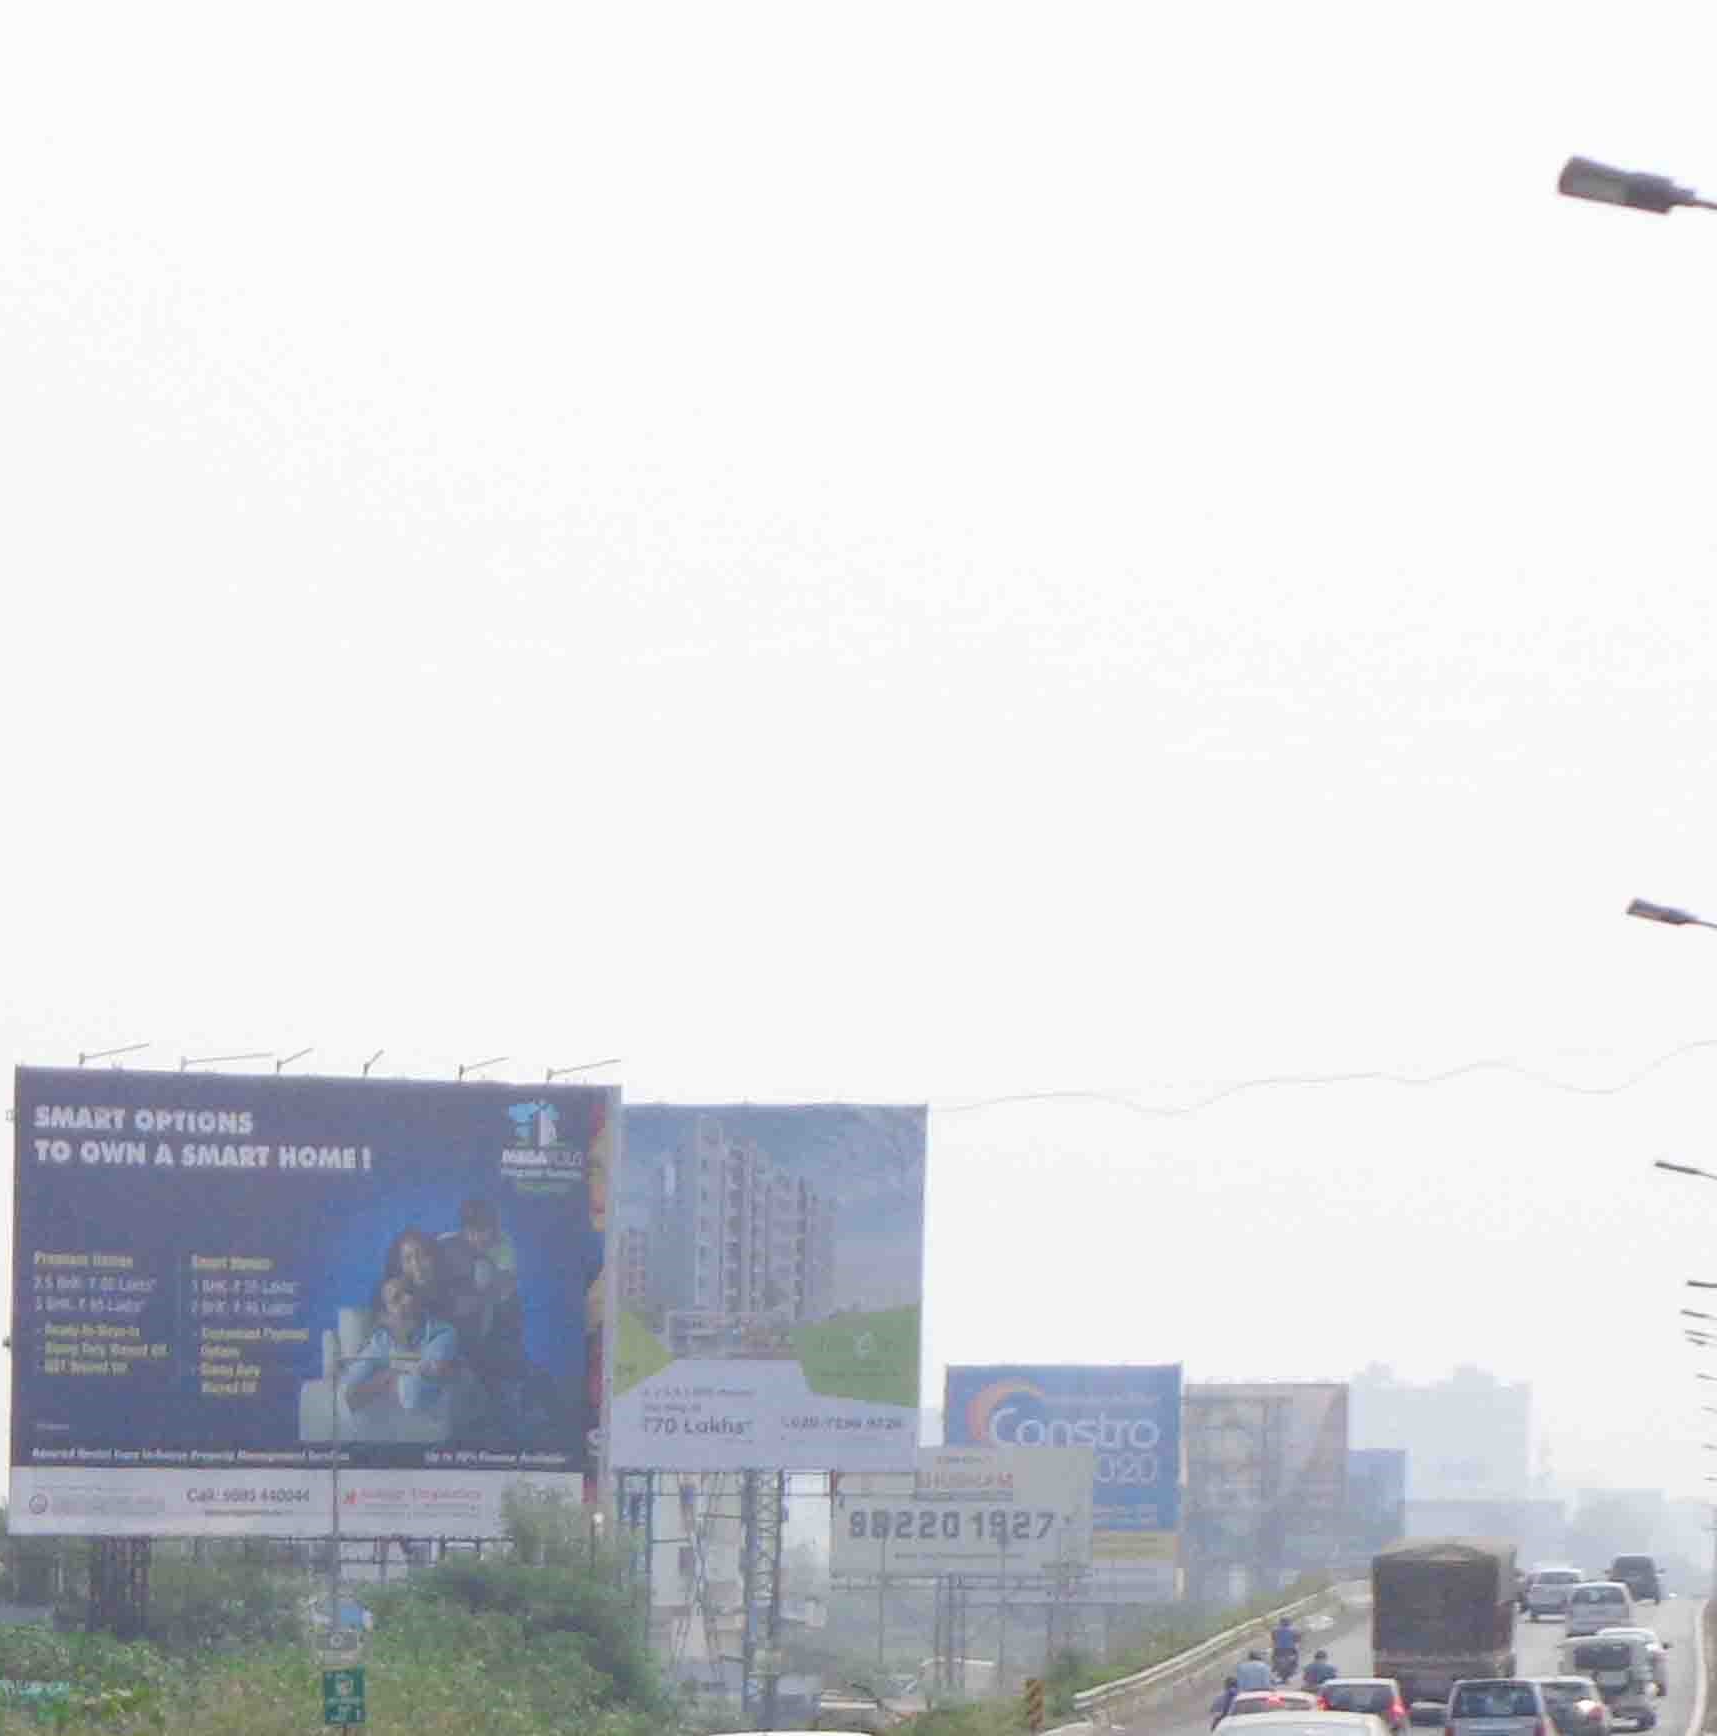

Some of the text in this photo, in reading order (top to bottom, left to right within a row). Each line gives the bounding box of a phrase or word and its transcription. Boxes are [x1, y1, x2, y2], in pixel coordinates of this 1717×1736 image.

[33, 1105, 254, 1135] SMART OPTIONS
[34, 1139, 70, 1163] TO
[80, 1141, 146, 1164] OWN
[154, 1143, 174, 1167] A
[181, 1143, 269, 1168] SMART
[988, 1408, 1162, 1450] Constro
[1091, 1453, 1159, 1484] 020
